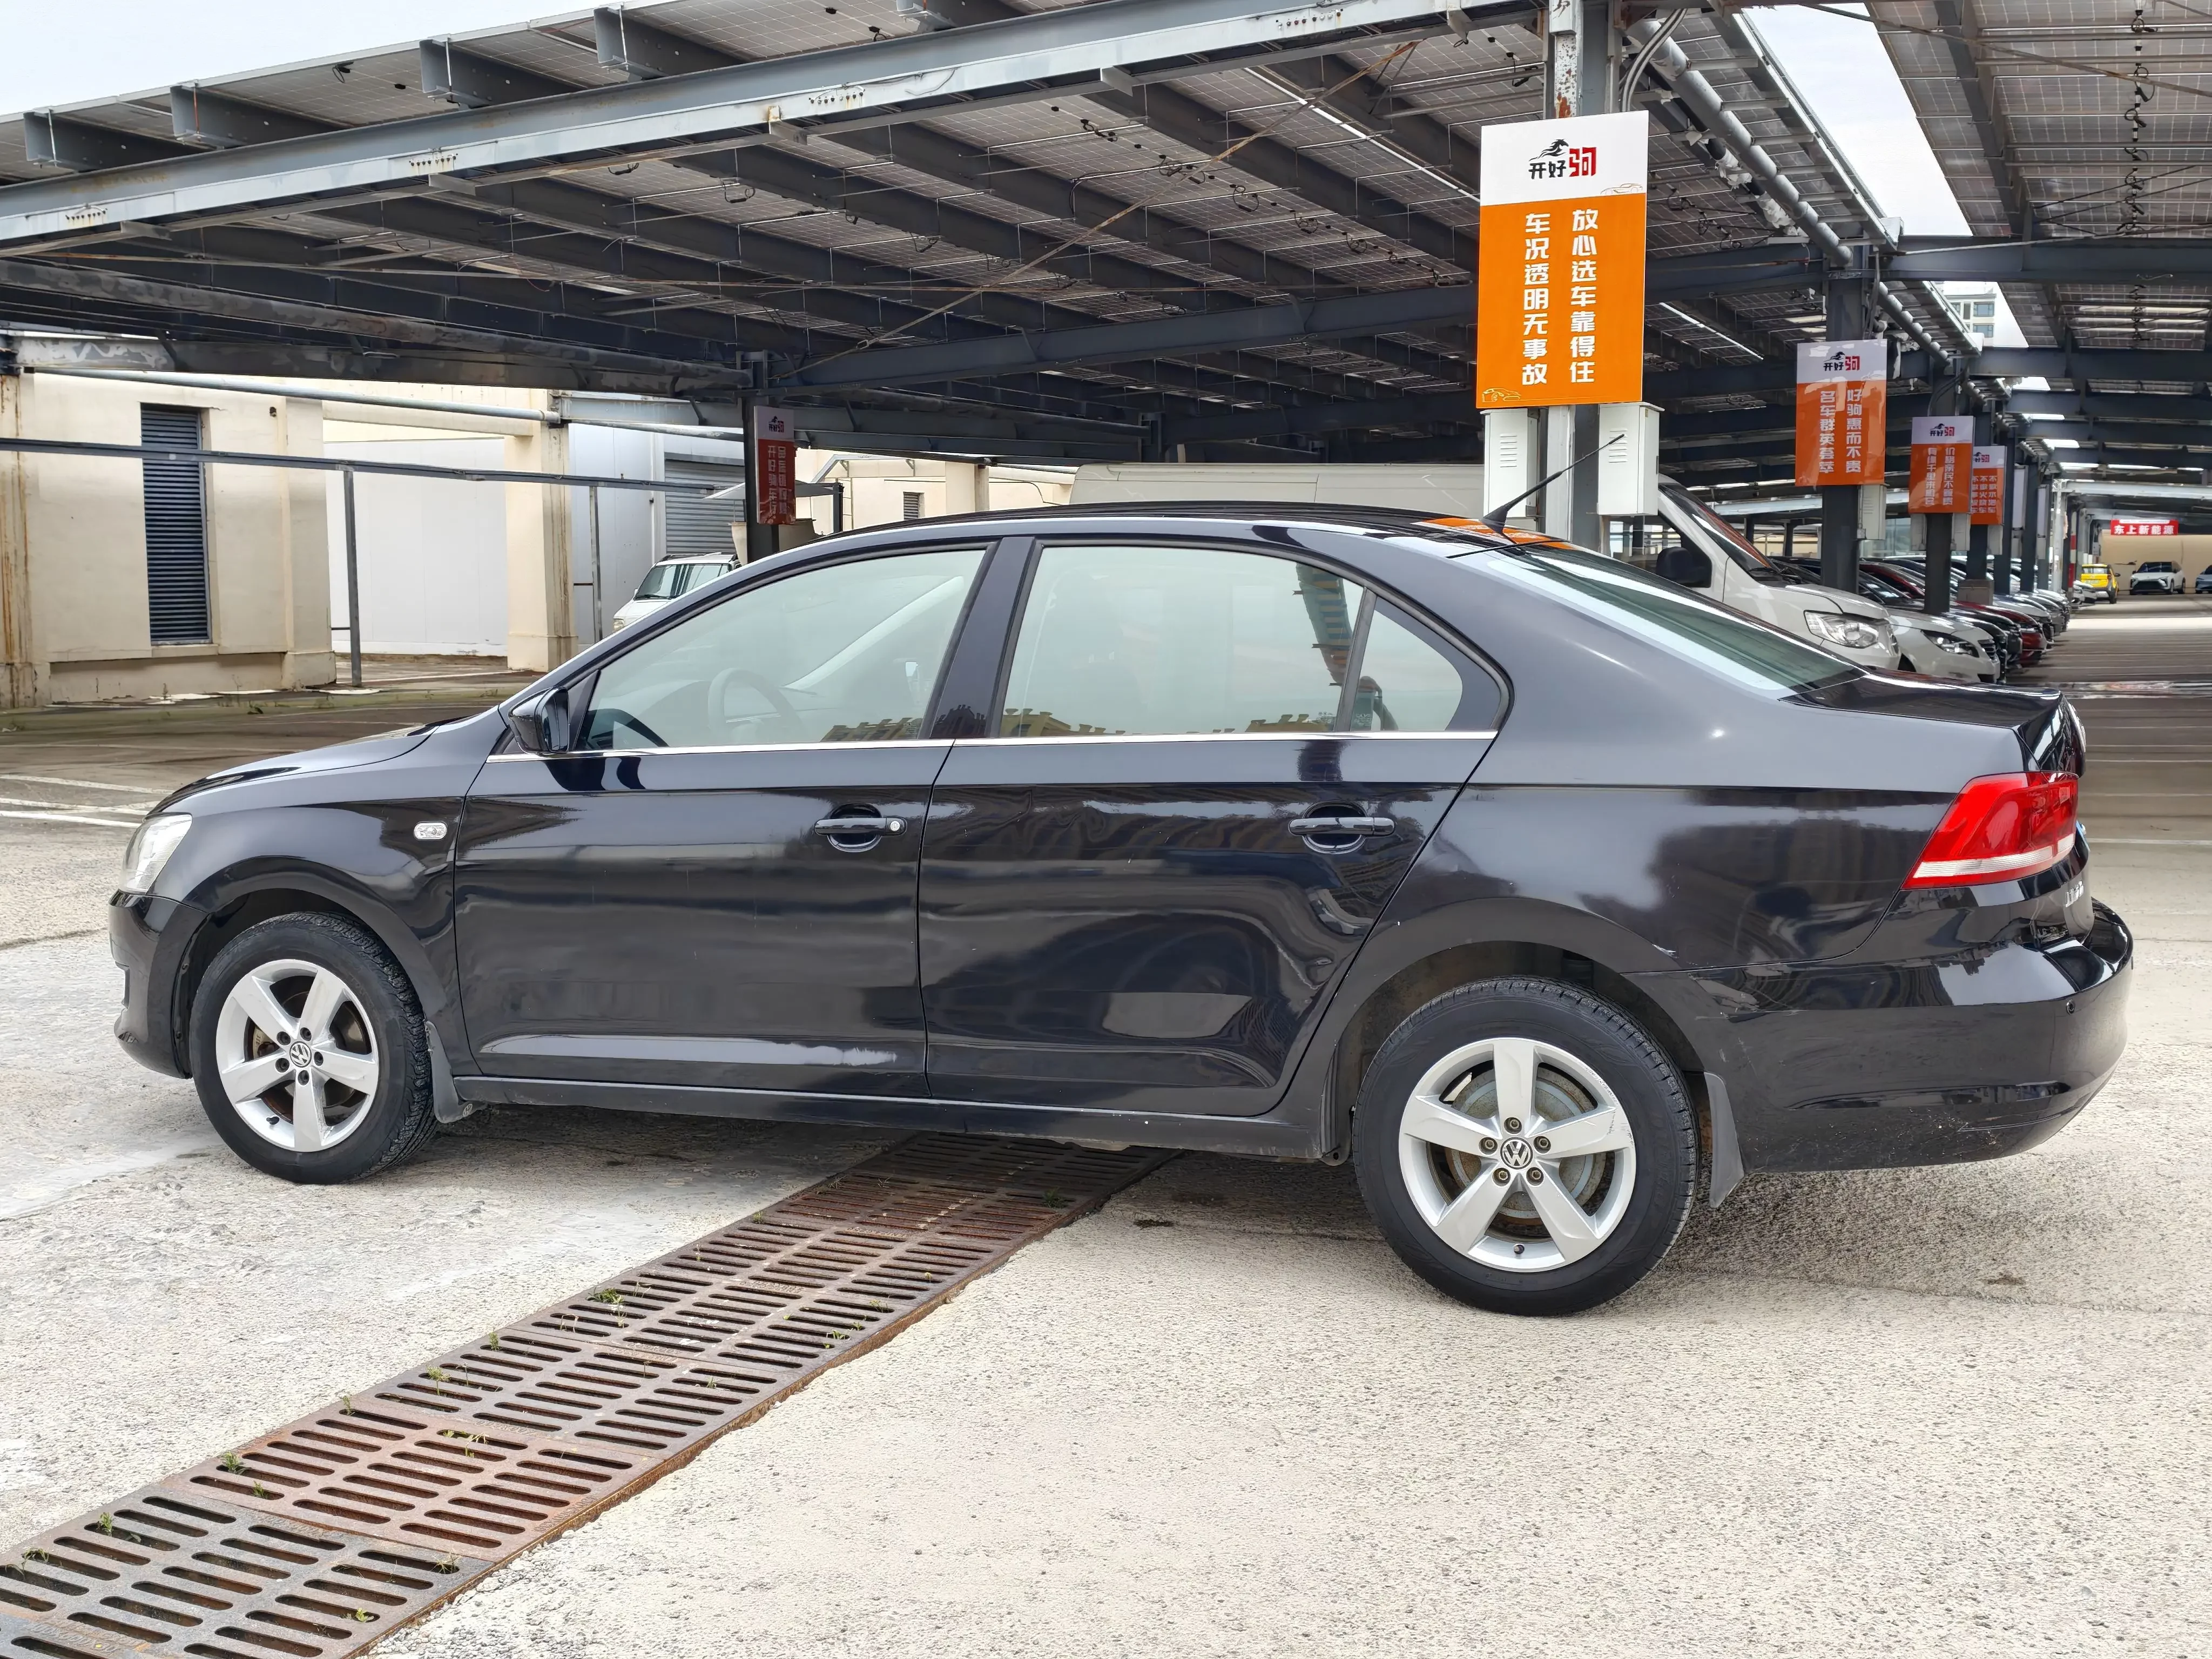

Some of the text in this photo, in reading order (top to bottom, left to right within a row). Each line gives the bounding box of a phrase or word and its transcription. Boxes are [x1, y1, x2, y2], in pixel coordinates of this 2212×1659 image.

[1522, 212, 1550, 386] 车况透明无事故
[1570, 208, 1599, 384] 放心选车靠得住
[1819, 391, 1836, 473] 名车群英荟萃
[1846, 389, 1863, 473] 好驹惠而不贵
